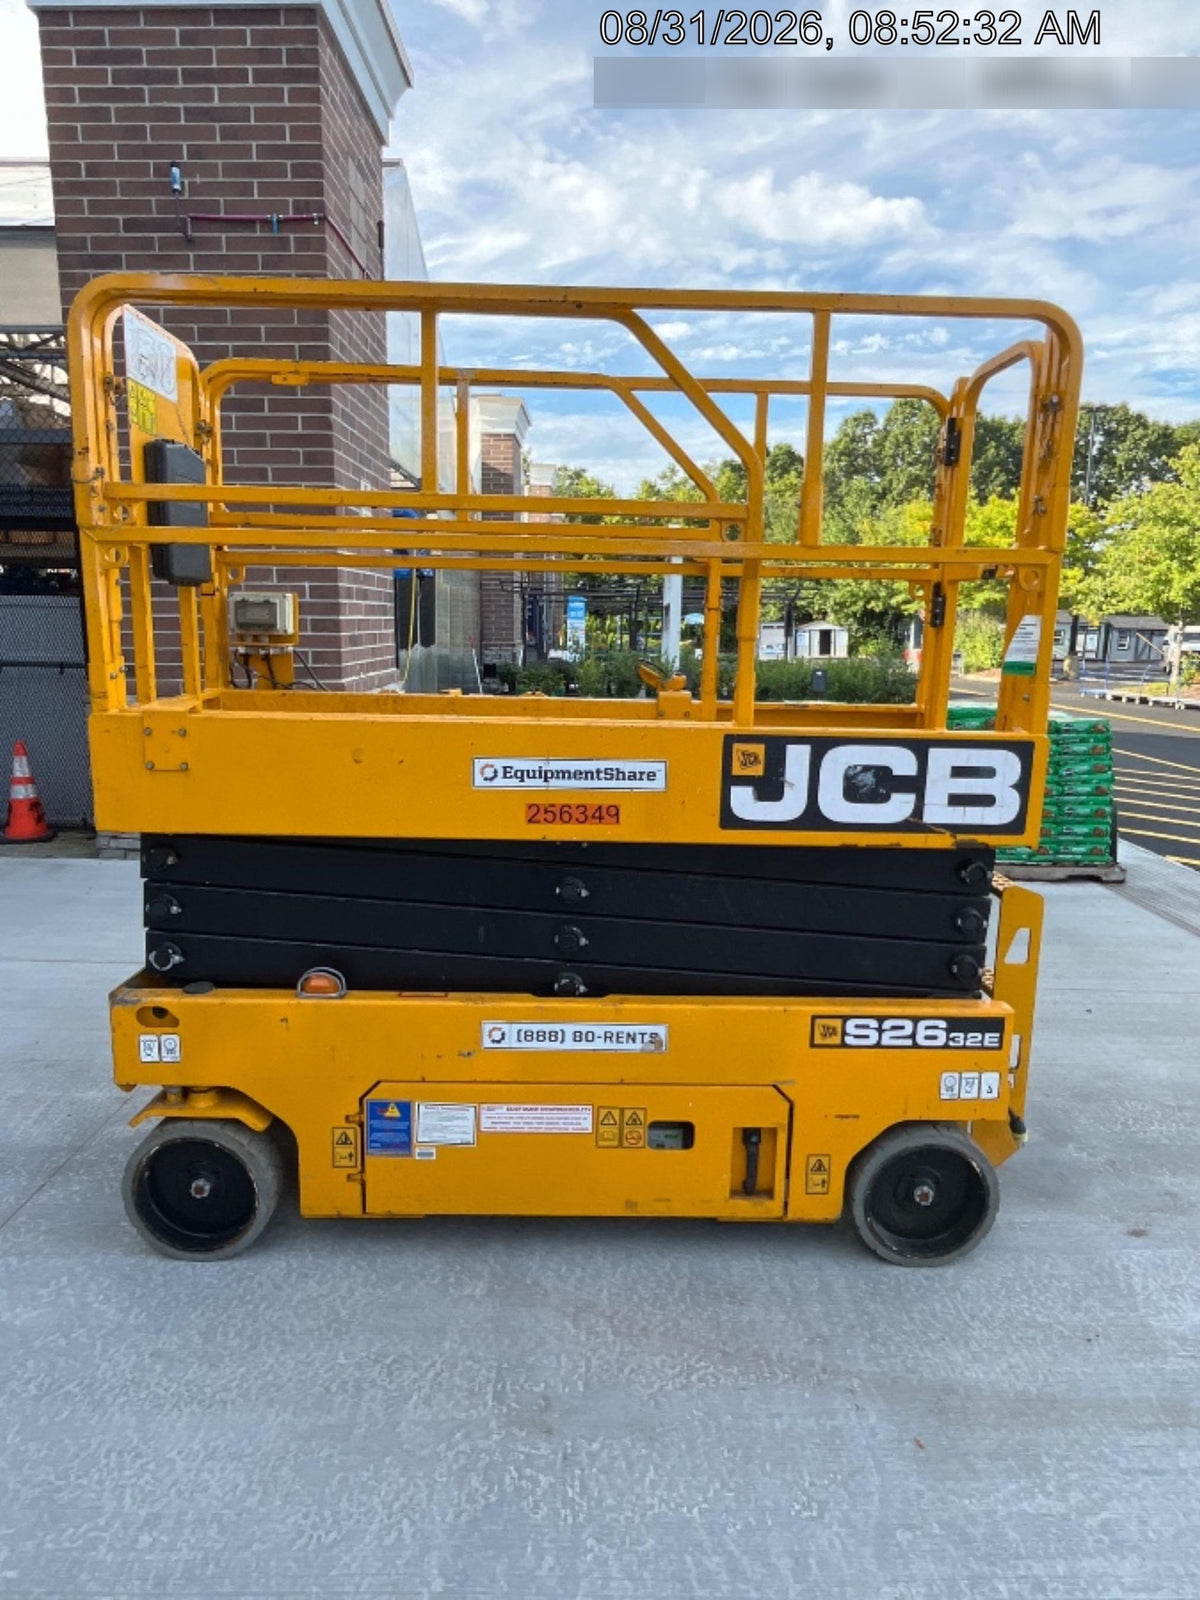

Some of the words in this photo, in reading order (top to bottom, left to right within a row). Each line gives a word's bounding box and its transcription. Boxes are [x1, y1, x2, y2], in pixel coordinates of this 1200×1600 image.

[502, 765, 657, 783] EquipmentShare
[730, 744, 1022, 825] JCB
[527, 804, 620, 825] 256349
[516, 1028, 566, 1044] (888)
[572, 1030, 659, 1045] 80-RENTS
